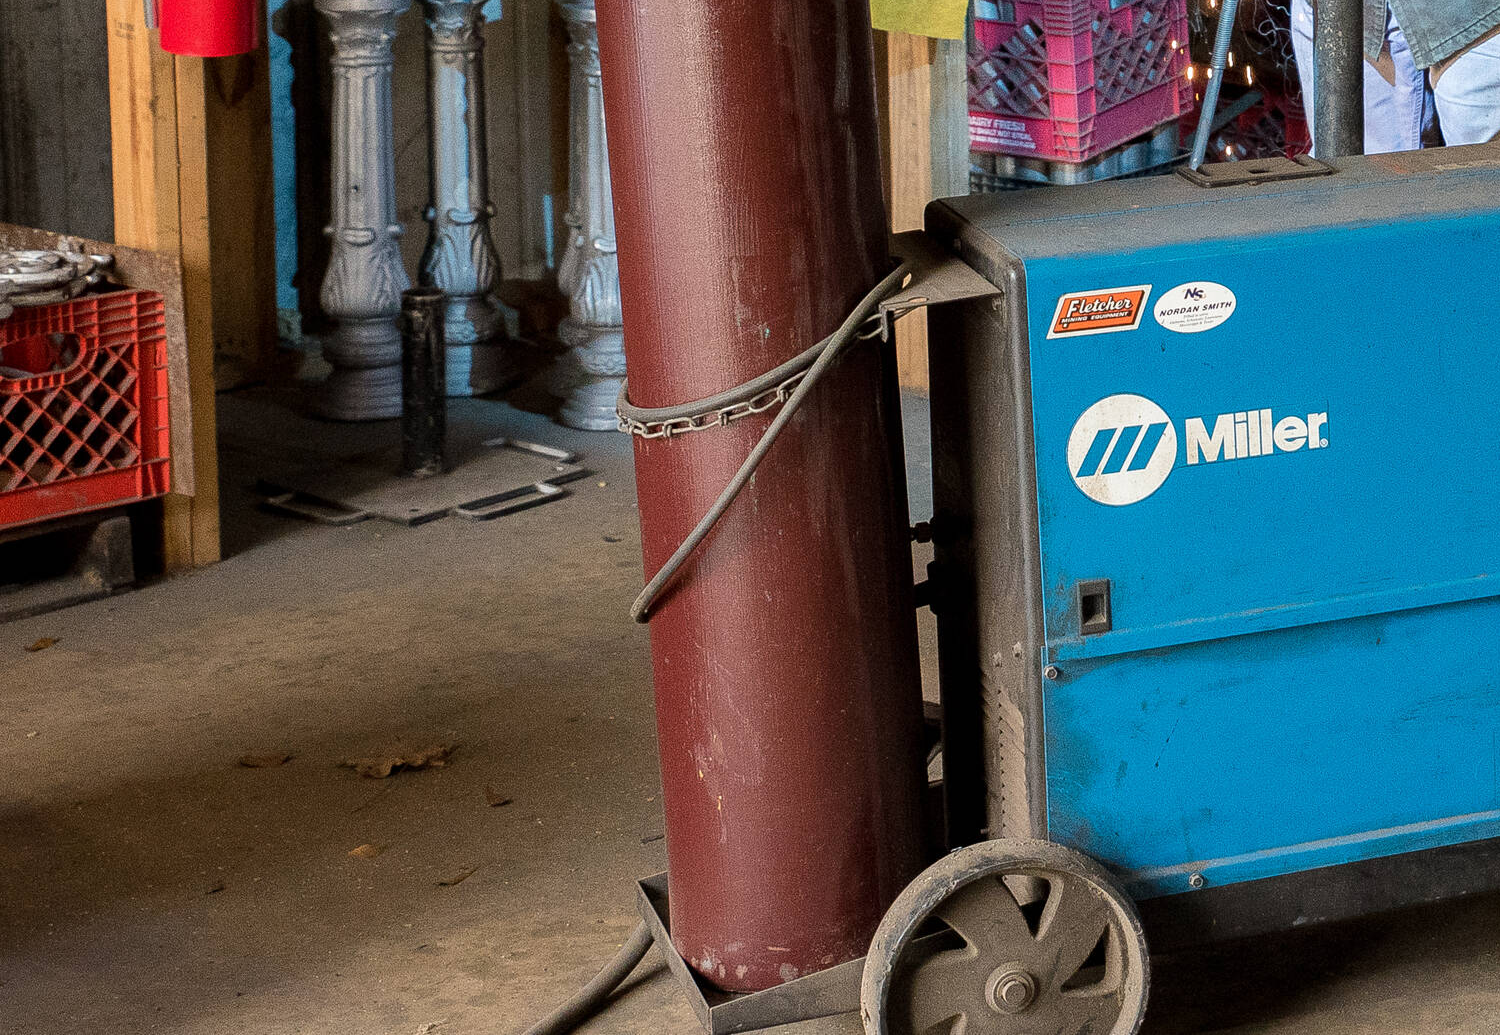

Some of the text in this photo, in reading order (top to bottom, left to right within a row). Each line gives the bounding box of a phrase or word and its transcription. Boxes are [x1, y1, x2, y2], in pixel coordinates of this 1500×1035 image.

[1066, 295, 1133, 317] Fletcher
[1159, 305, 1200, 317] NORDAN
[1202, 301, 1233, 311] SMITH
[1061, 311, 1129, 324] MINING EQUIPMENT
[1185, 408, 1328, 465] Miller
